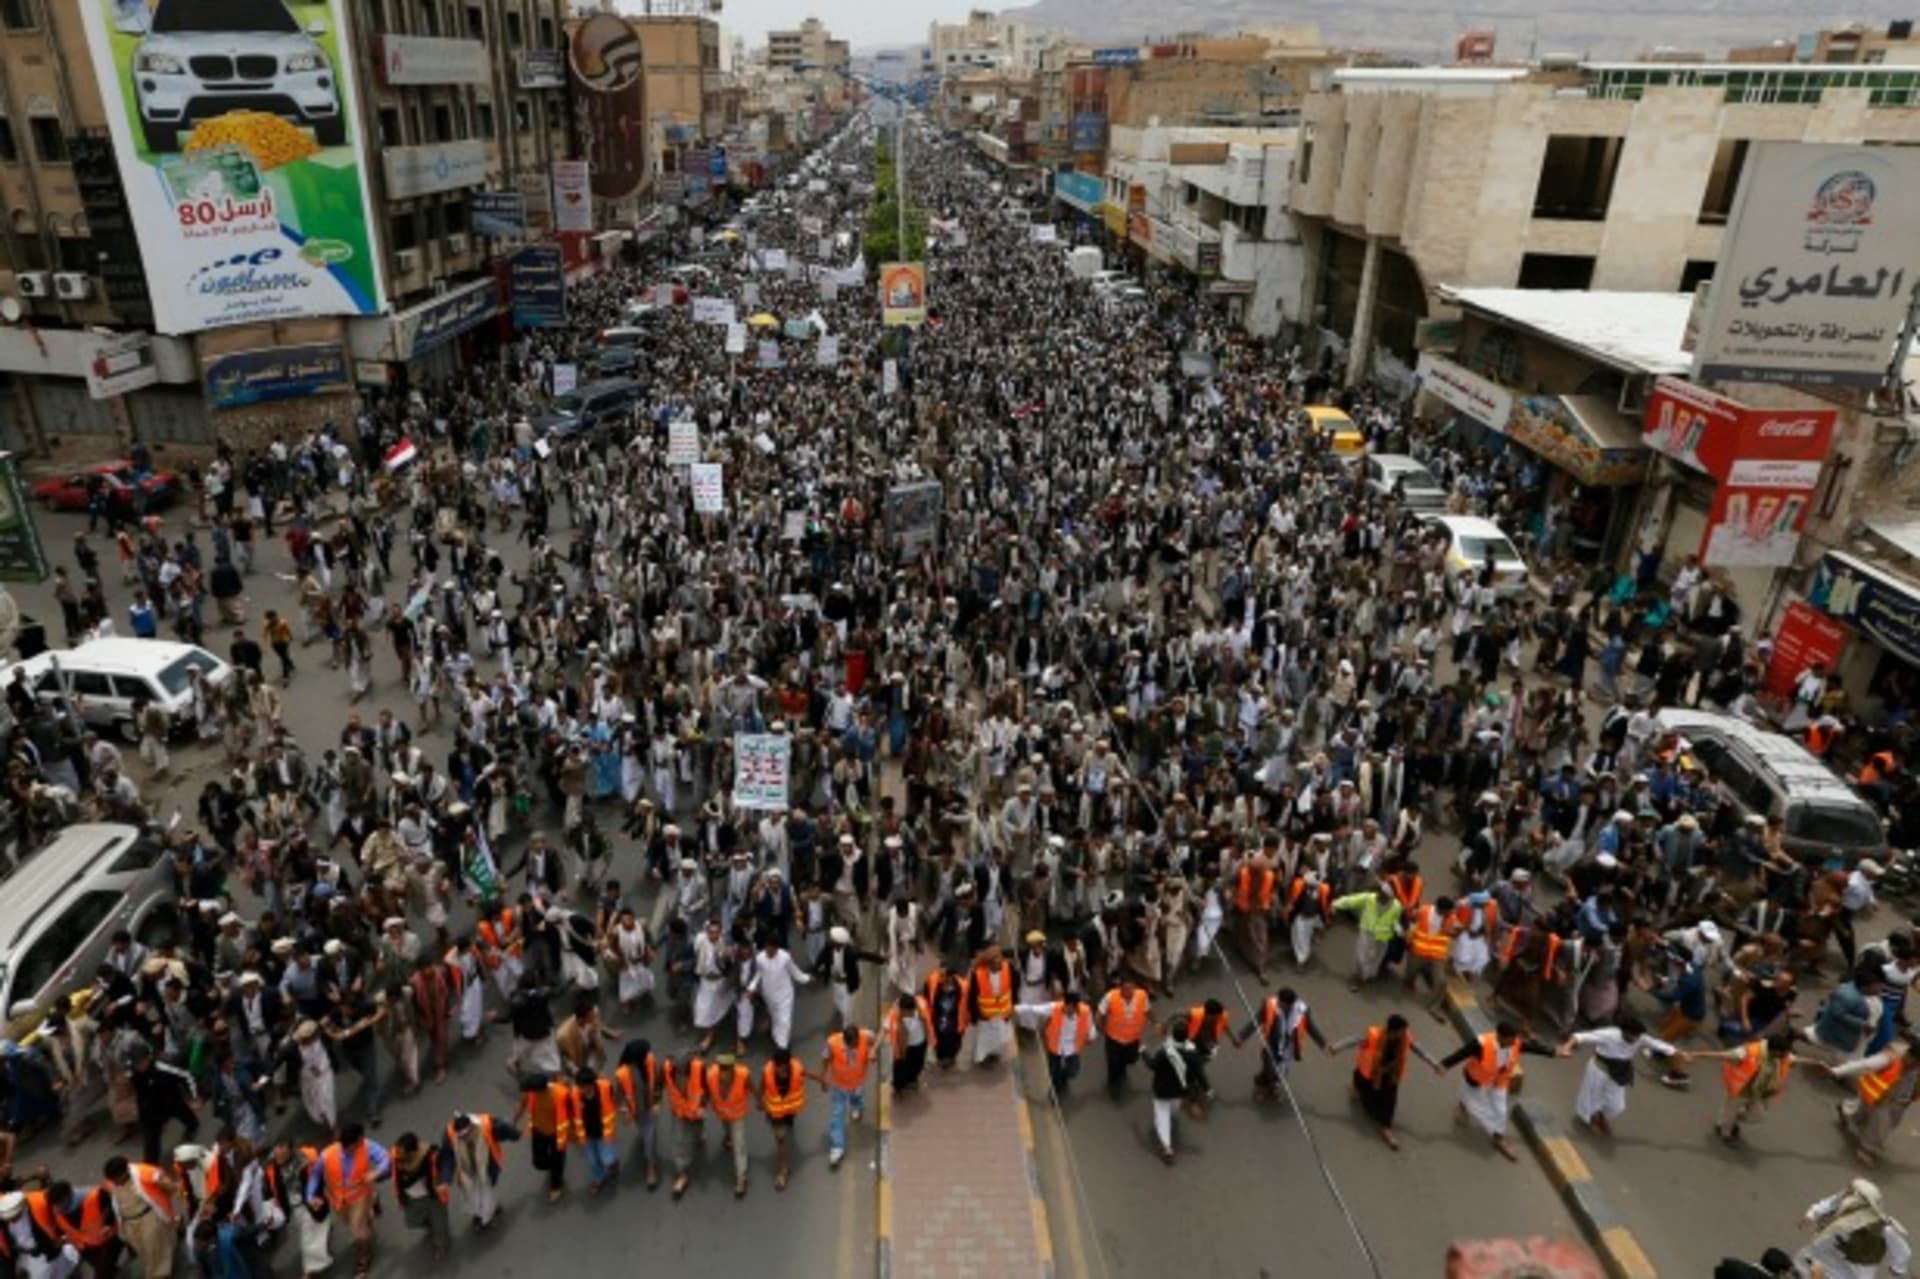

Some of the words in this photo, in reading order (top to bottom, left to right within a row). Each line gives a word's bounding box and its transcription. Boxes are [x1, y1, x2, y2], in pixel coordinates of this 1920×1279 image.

[178, 201, 216, 225] 80
[220, 189, 271, 222] أرسل
[1738, 263, 1904, 308] العامري
[1727, 319, 1815, 345] والتحويلات
[1819, 321, 1887, 344] للصرافة
